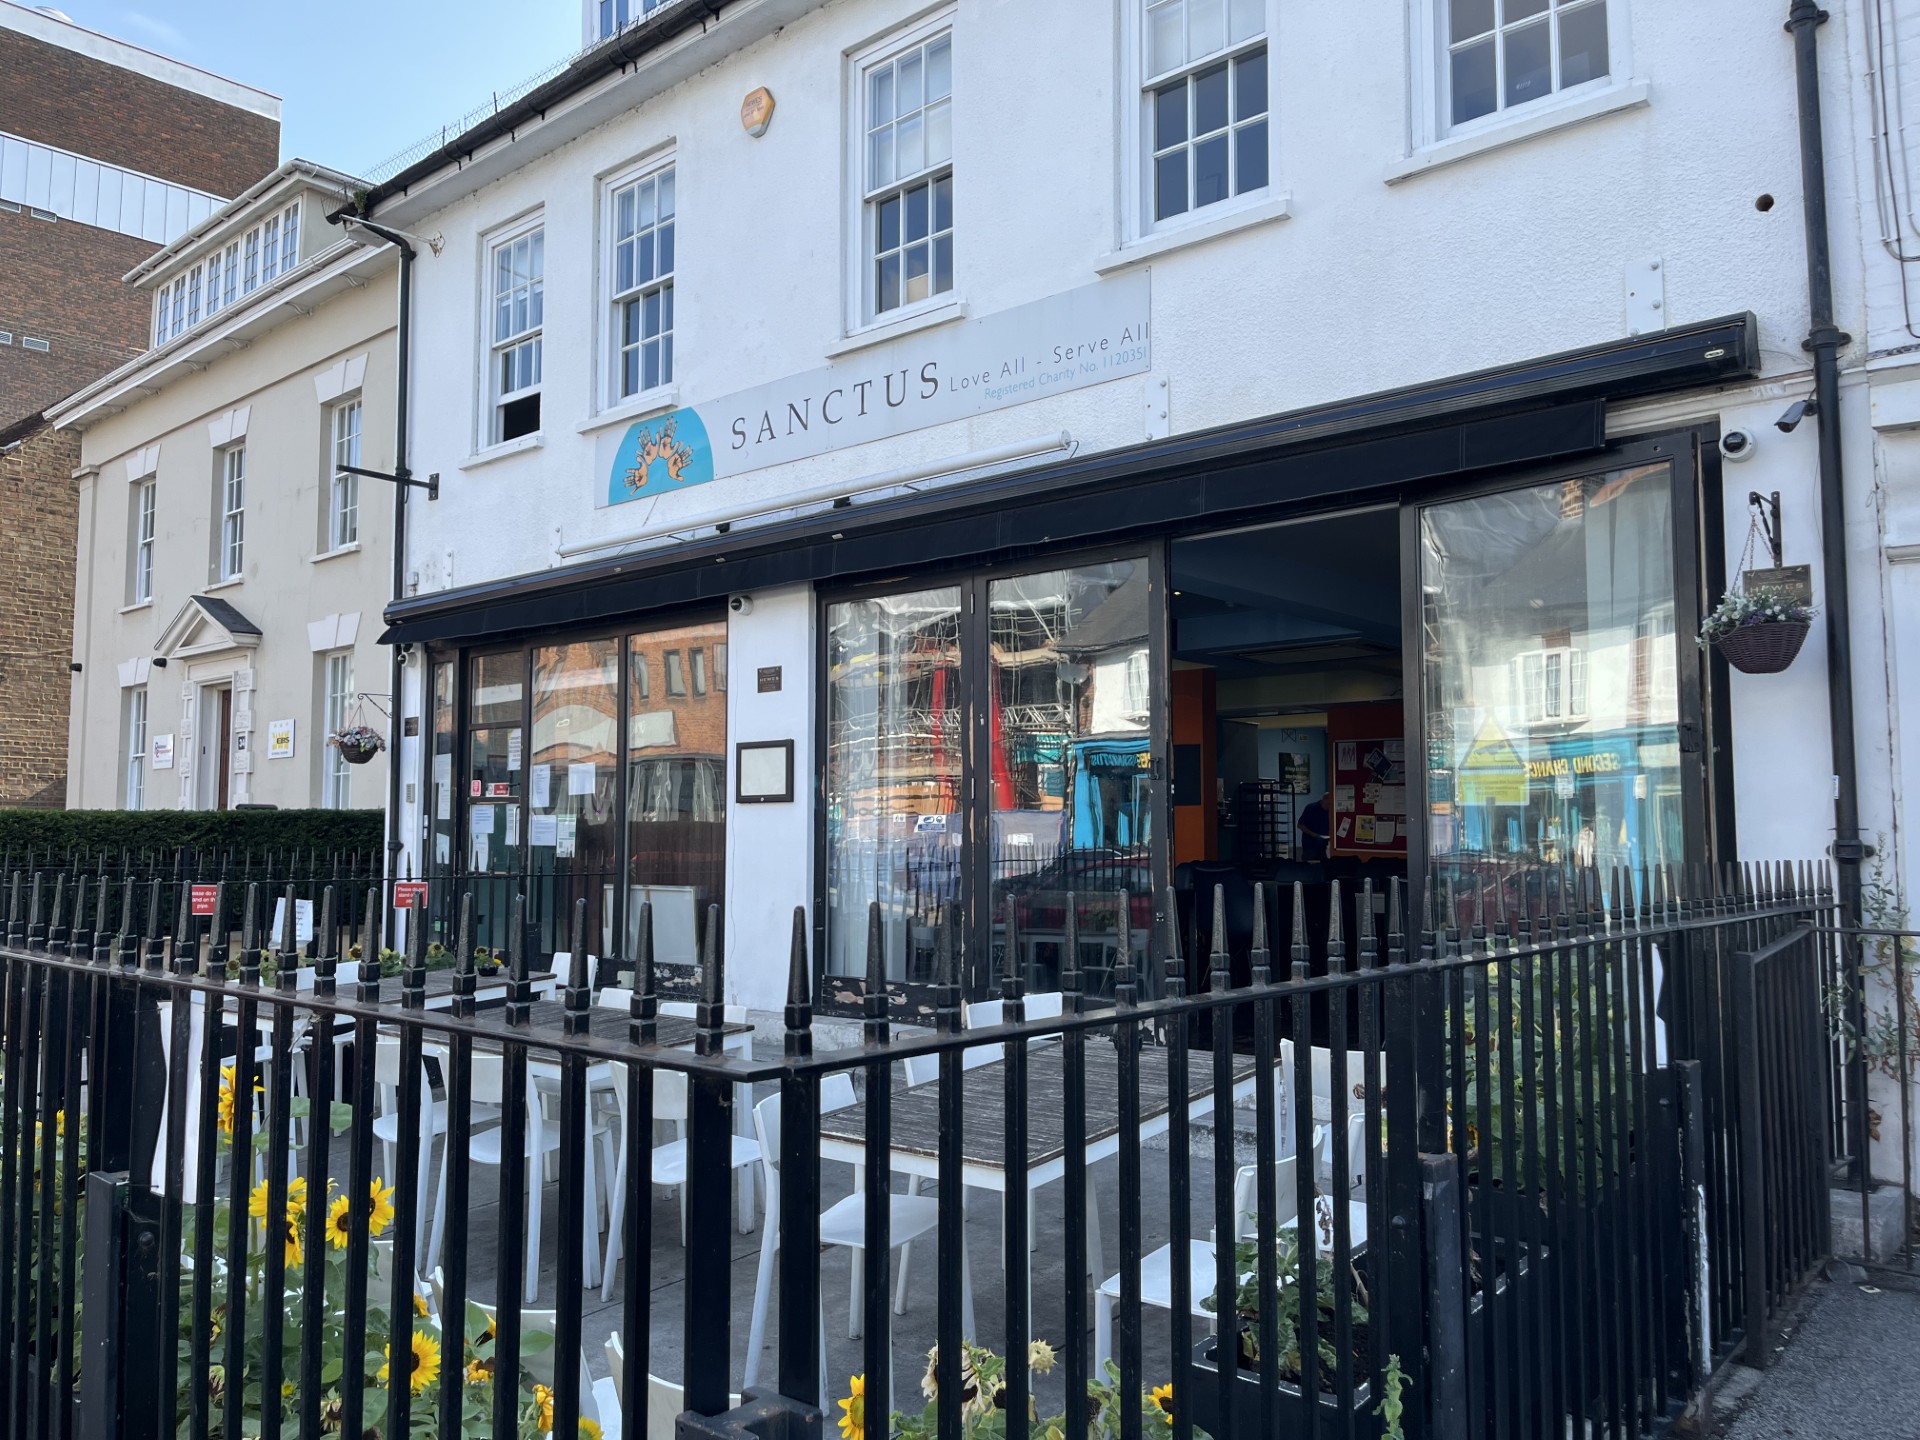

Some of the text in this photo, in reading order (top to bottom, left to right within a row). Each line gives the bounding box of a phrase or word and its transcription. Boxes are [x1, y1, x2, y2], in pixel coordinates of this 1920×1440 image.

[950, 371, 991, 392] Love
[1000, 356, 1025, 379] All
[1053, 337, 1109, 364] Serve
[1120, 321, 1149, 346] All
[984, 345, 1147, 400] Registered Charity No. 1120351
[731, 361, 939, 450] SANCTUS
